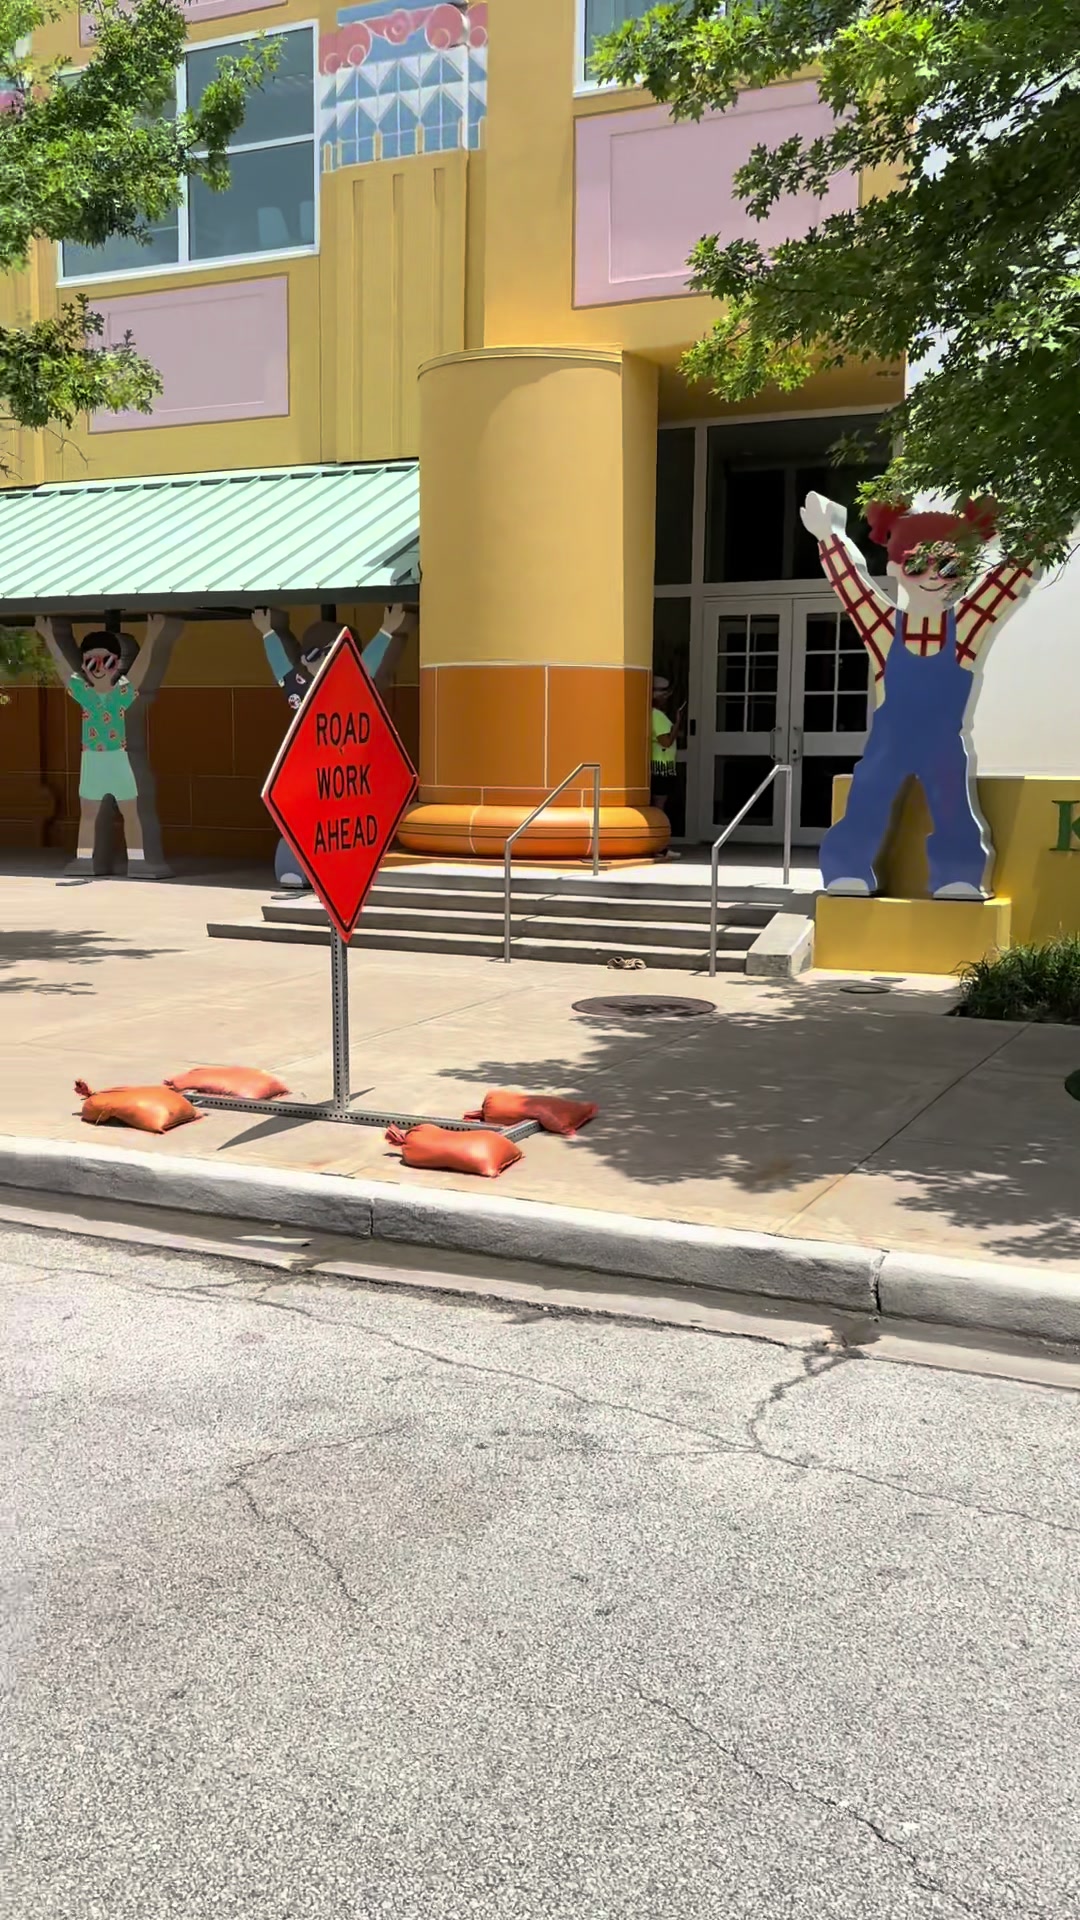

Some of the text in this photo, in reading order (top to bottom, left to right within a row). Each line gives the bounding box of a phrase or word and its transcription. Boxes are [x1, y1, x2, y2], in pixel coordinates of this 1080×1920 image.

[316, 712, 370, 746] ROAD
[316, 763, 371, 800] WORK
[314, 814, 378, 855] AHEAD
